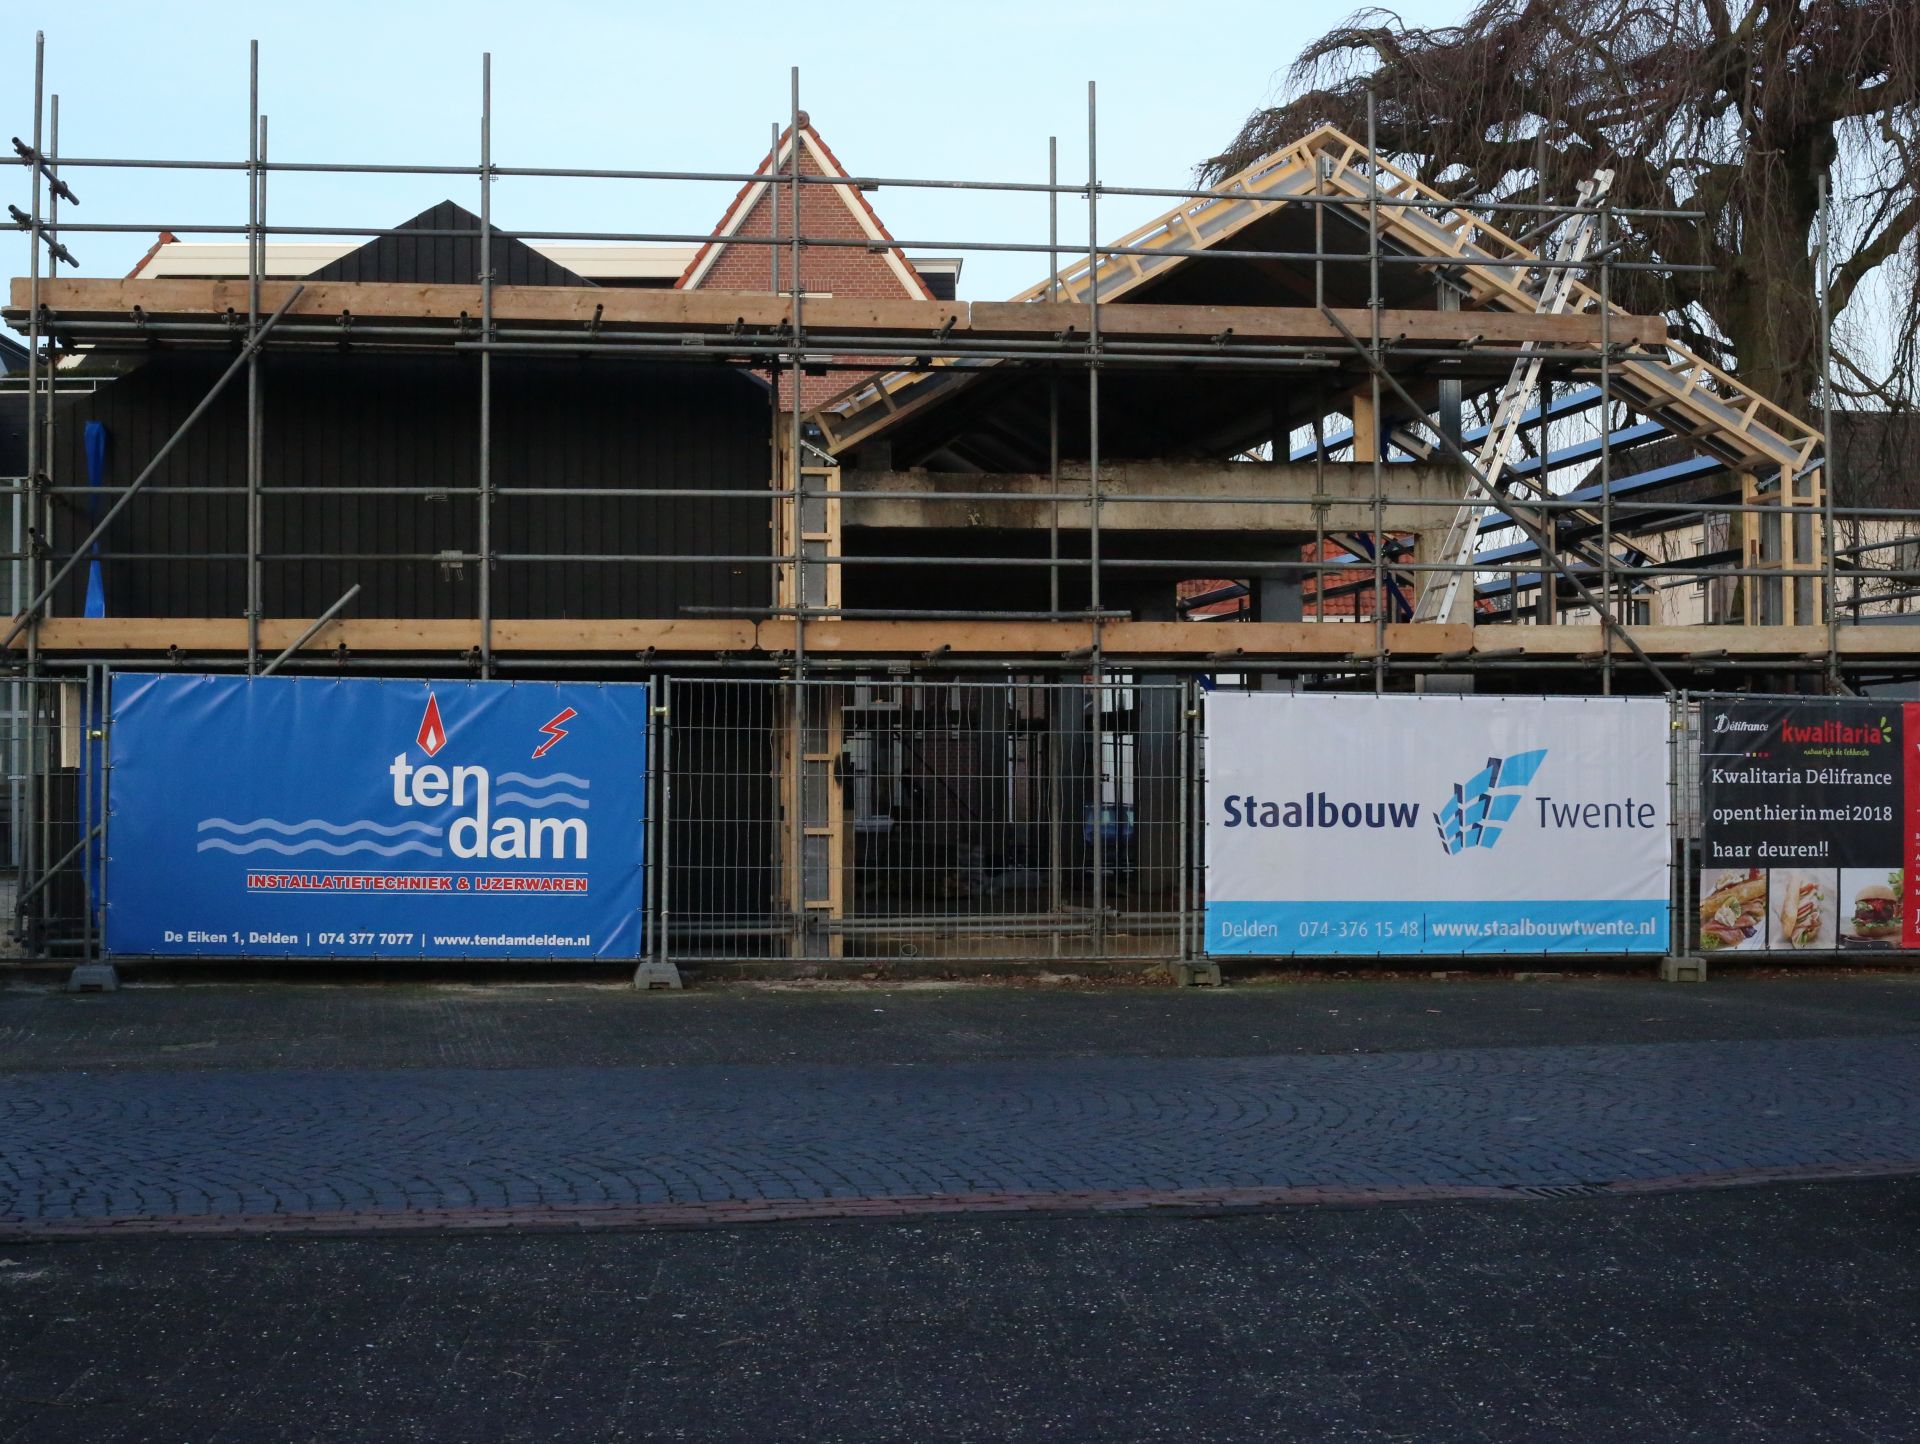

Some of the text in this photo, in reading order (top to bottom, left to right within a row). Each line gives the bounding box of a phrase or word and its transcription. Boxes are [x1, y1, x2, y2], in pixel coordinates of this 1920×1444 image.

[1712, 712, 1769, 734] Délifrance
[1781, 719, 1882, 744] kwalitaria
[389, 751, 490, 807] ten
[1711, 768, 1892, 786] Kwalitaria Délifrance
[1223, 792, 1656, 829] Staalbouw Twente
[1712, 804, 1893, 825] opent hier in mei 2018
[448, 815, 588, 859] dam
[1712, 841, 1829, 857] haar deuren!!
[246, 874, 588, 891] INSTALLATIETECHNIEK & IJZERWAREN
[1221, 920, 1278, 937] Delden
[1375, 922, 1393, 937] 15
[1399, 922, 1419, 937] 48
[1432, 916, 1656, 937] www.staalbouwtwente.nl
[164, 931, 590, 946] De Eiken 1, Delden 074 377 7077 www.tendamdelden.nl
